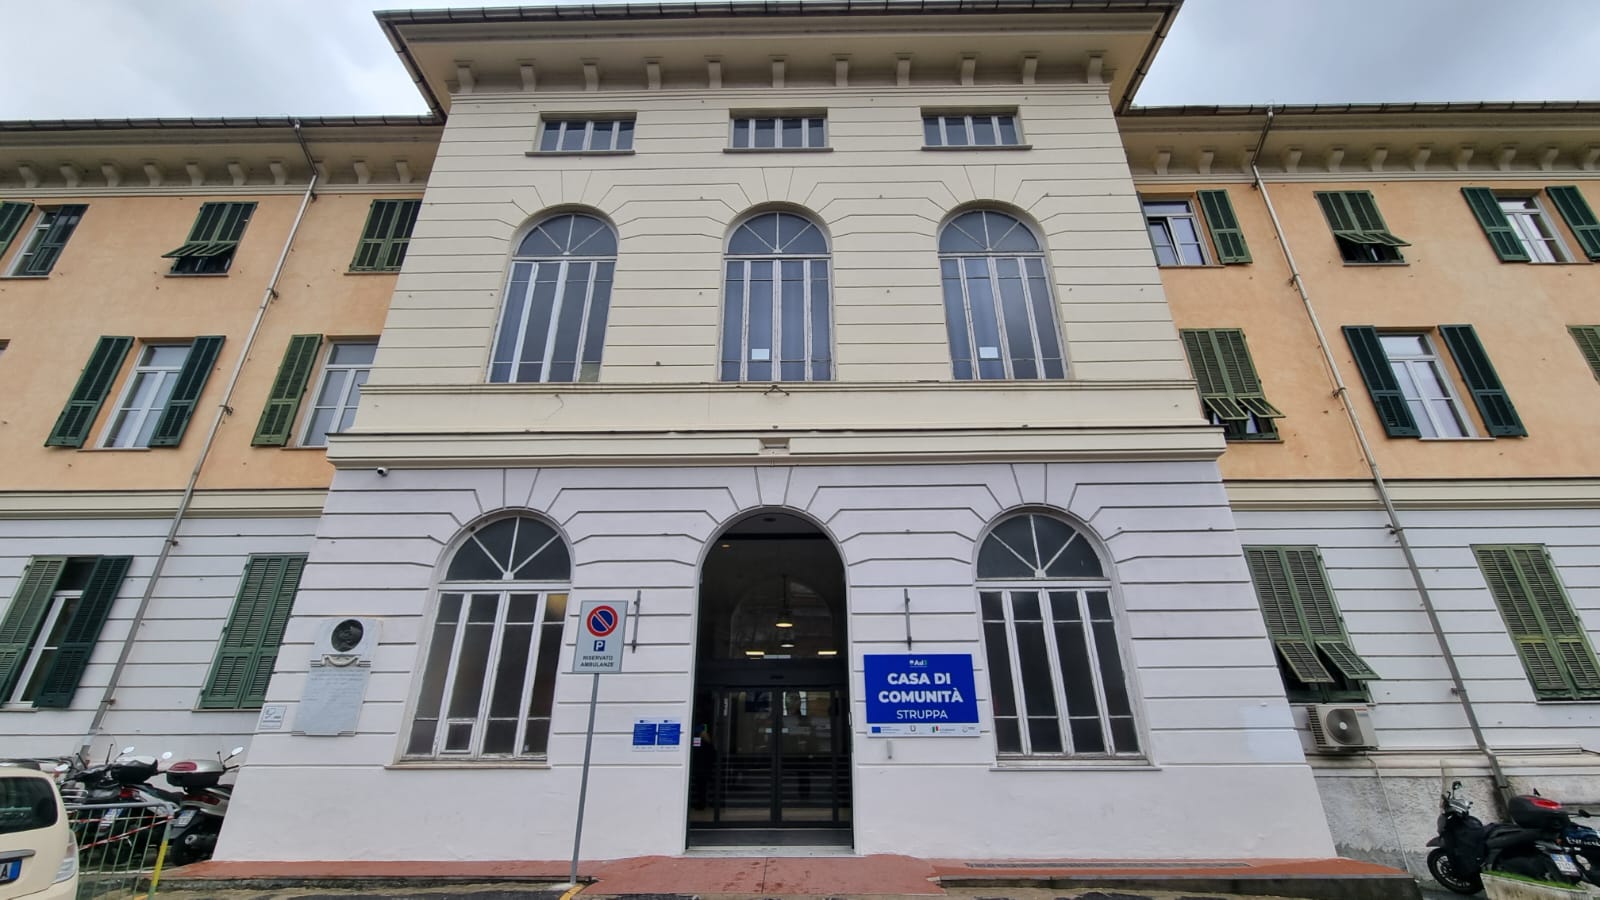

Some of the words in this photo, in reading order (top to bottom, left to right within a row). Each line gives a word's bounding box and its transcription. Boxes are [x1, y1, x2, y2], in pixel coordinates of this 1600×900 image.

[596, 641, 603, 651] P
[887, 672, 931, 685] CASA
[934, 672, 951, 685] DI
[878, 687, 964, 703] COMUNITÀ
[896, 709, 949, 720] STRUPPA
